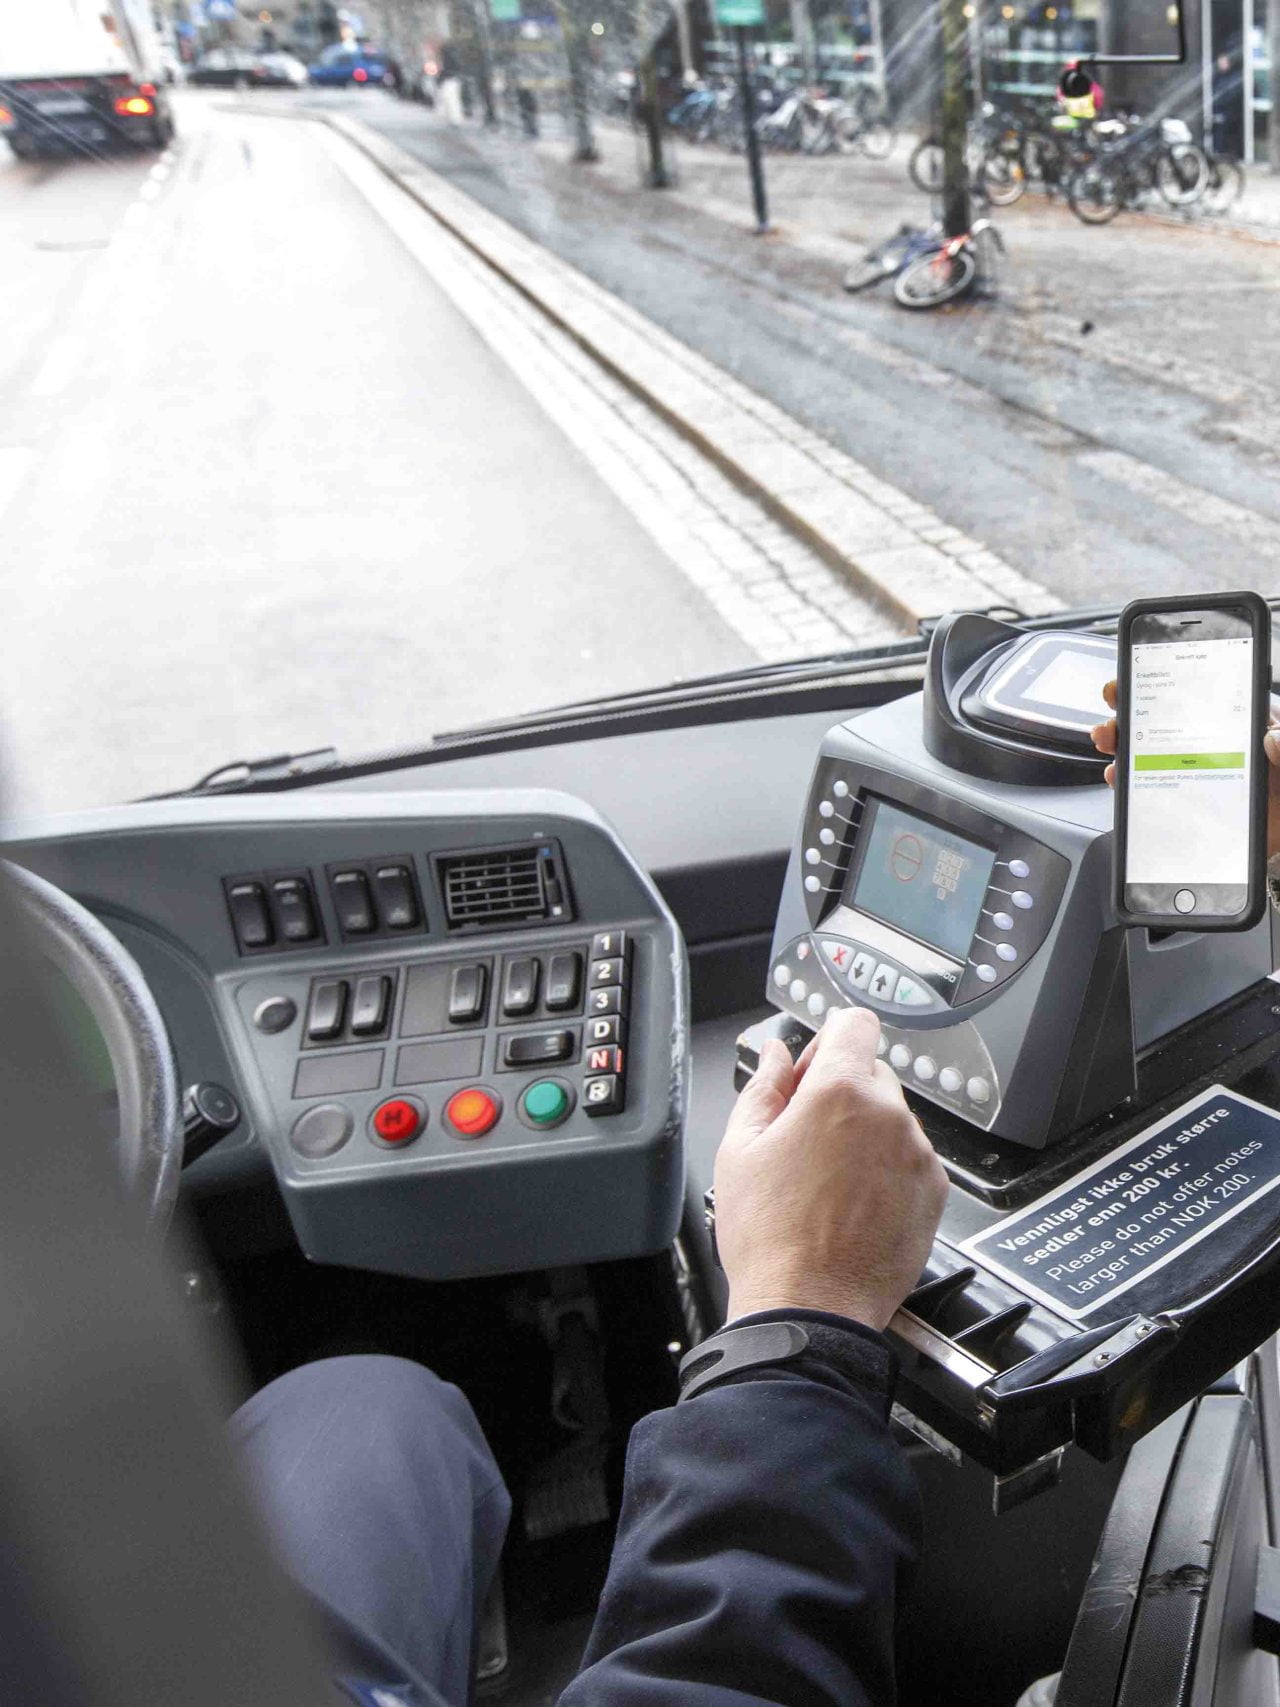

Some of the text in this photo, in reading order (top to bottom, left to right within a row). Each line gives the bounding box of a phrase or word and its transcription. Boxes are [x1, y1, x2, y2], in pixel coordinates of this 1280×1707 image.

[600, 935, 611, 951] 1
[597, 962, 611, 979] 2
[595, 992, 609, 1008] 3
[593, 1021, 611, 1038] D
[591, 1050, 608, 1069] N
[588, 1081, 609, 1102] R
[384, 1109, 403, 1128] H
[997, 1108, 1230, 1251] Vennligst ikke bruk større
[1022, 1162, 1190, 1265] sedler enn 200 kr.
[1045, 1140, 1263, 1280] Please do not offer notes
[1067, 1173, 1257, 1294] larger than NOK 200.
